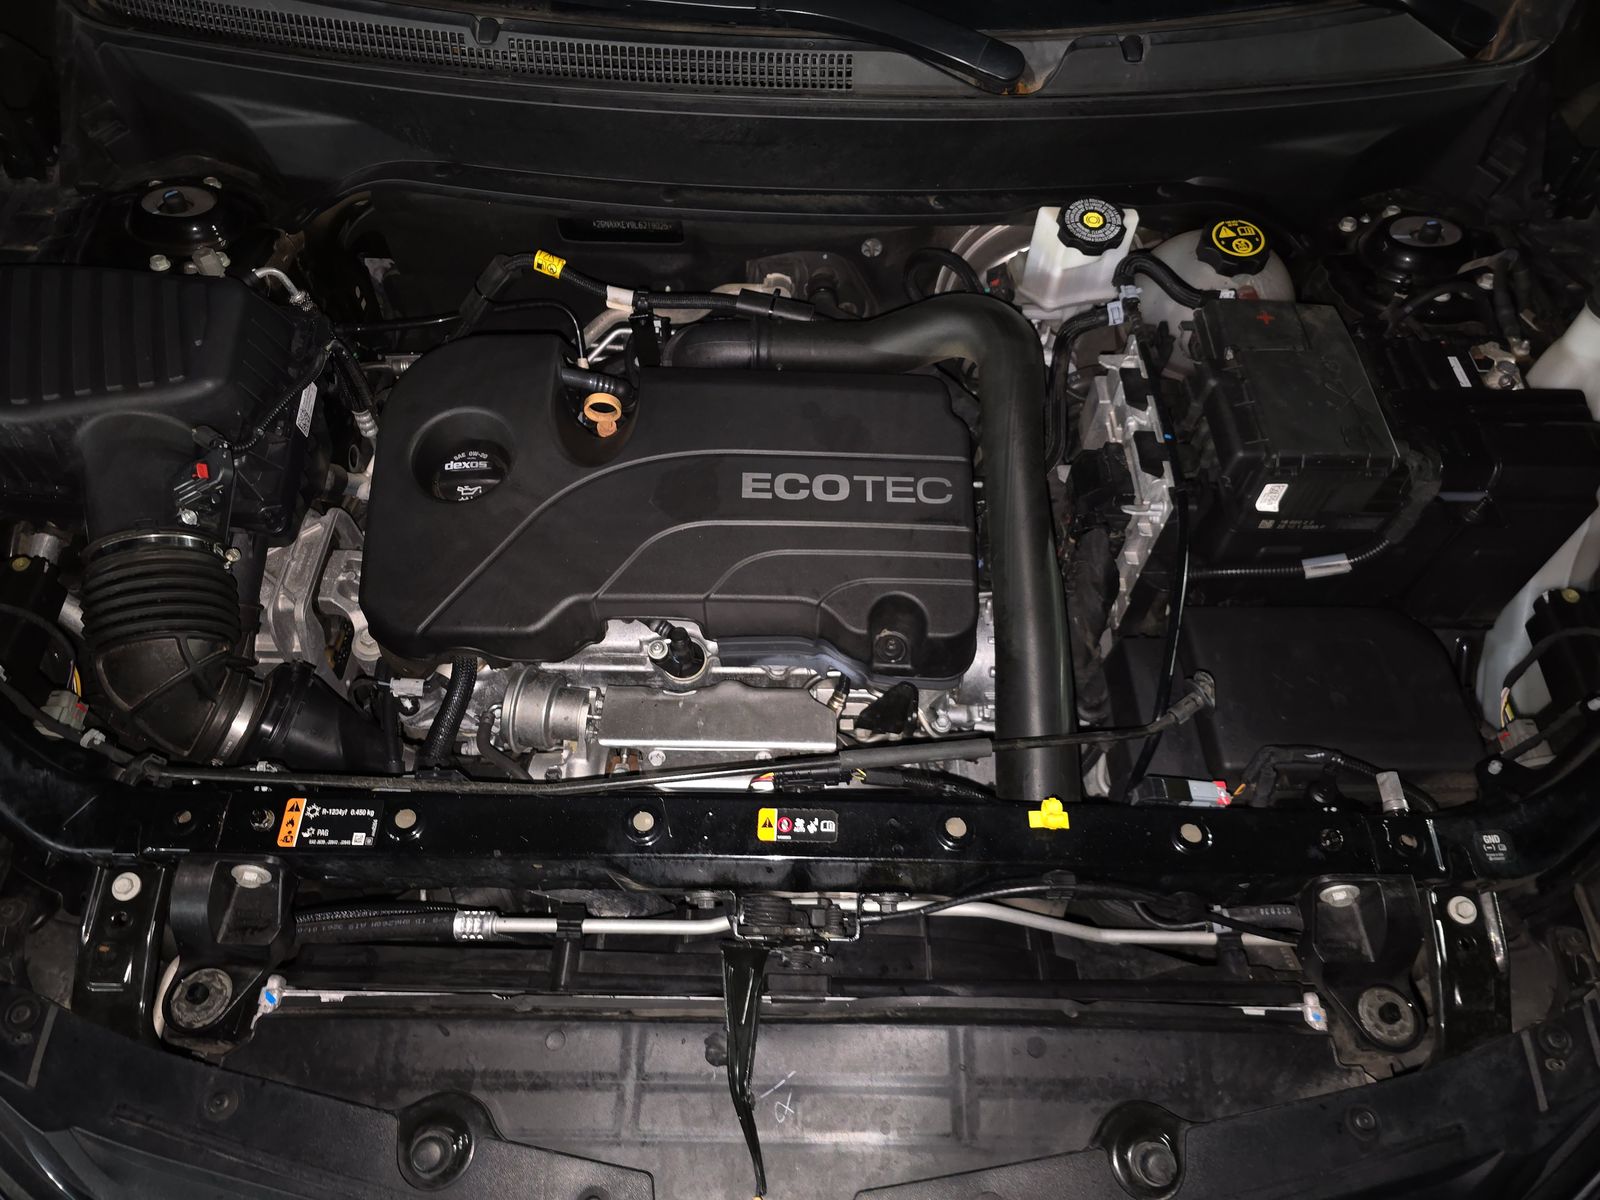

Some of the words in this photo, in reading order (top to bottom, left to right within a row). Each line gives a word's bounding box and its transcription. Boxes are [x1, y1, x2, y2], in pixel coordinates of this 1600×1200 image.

[453, 452, 466, 461] SAE
[444, 460, 489, 471] dexos
[741, 472, 953, 504] ECOTEC
[366, 808, 375, 817] kg
[316, 828, 329, 837] PAG
[1482, 834, 1501, 844] GND
